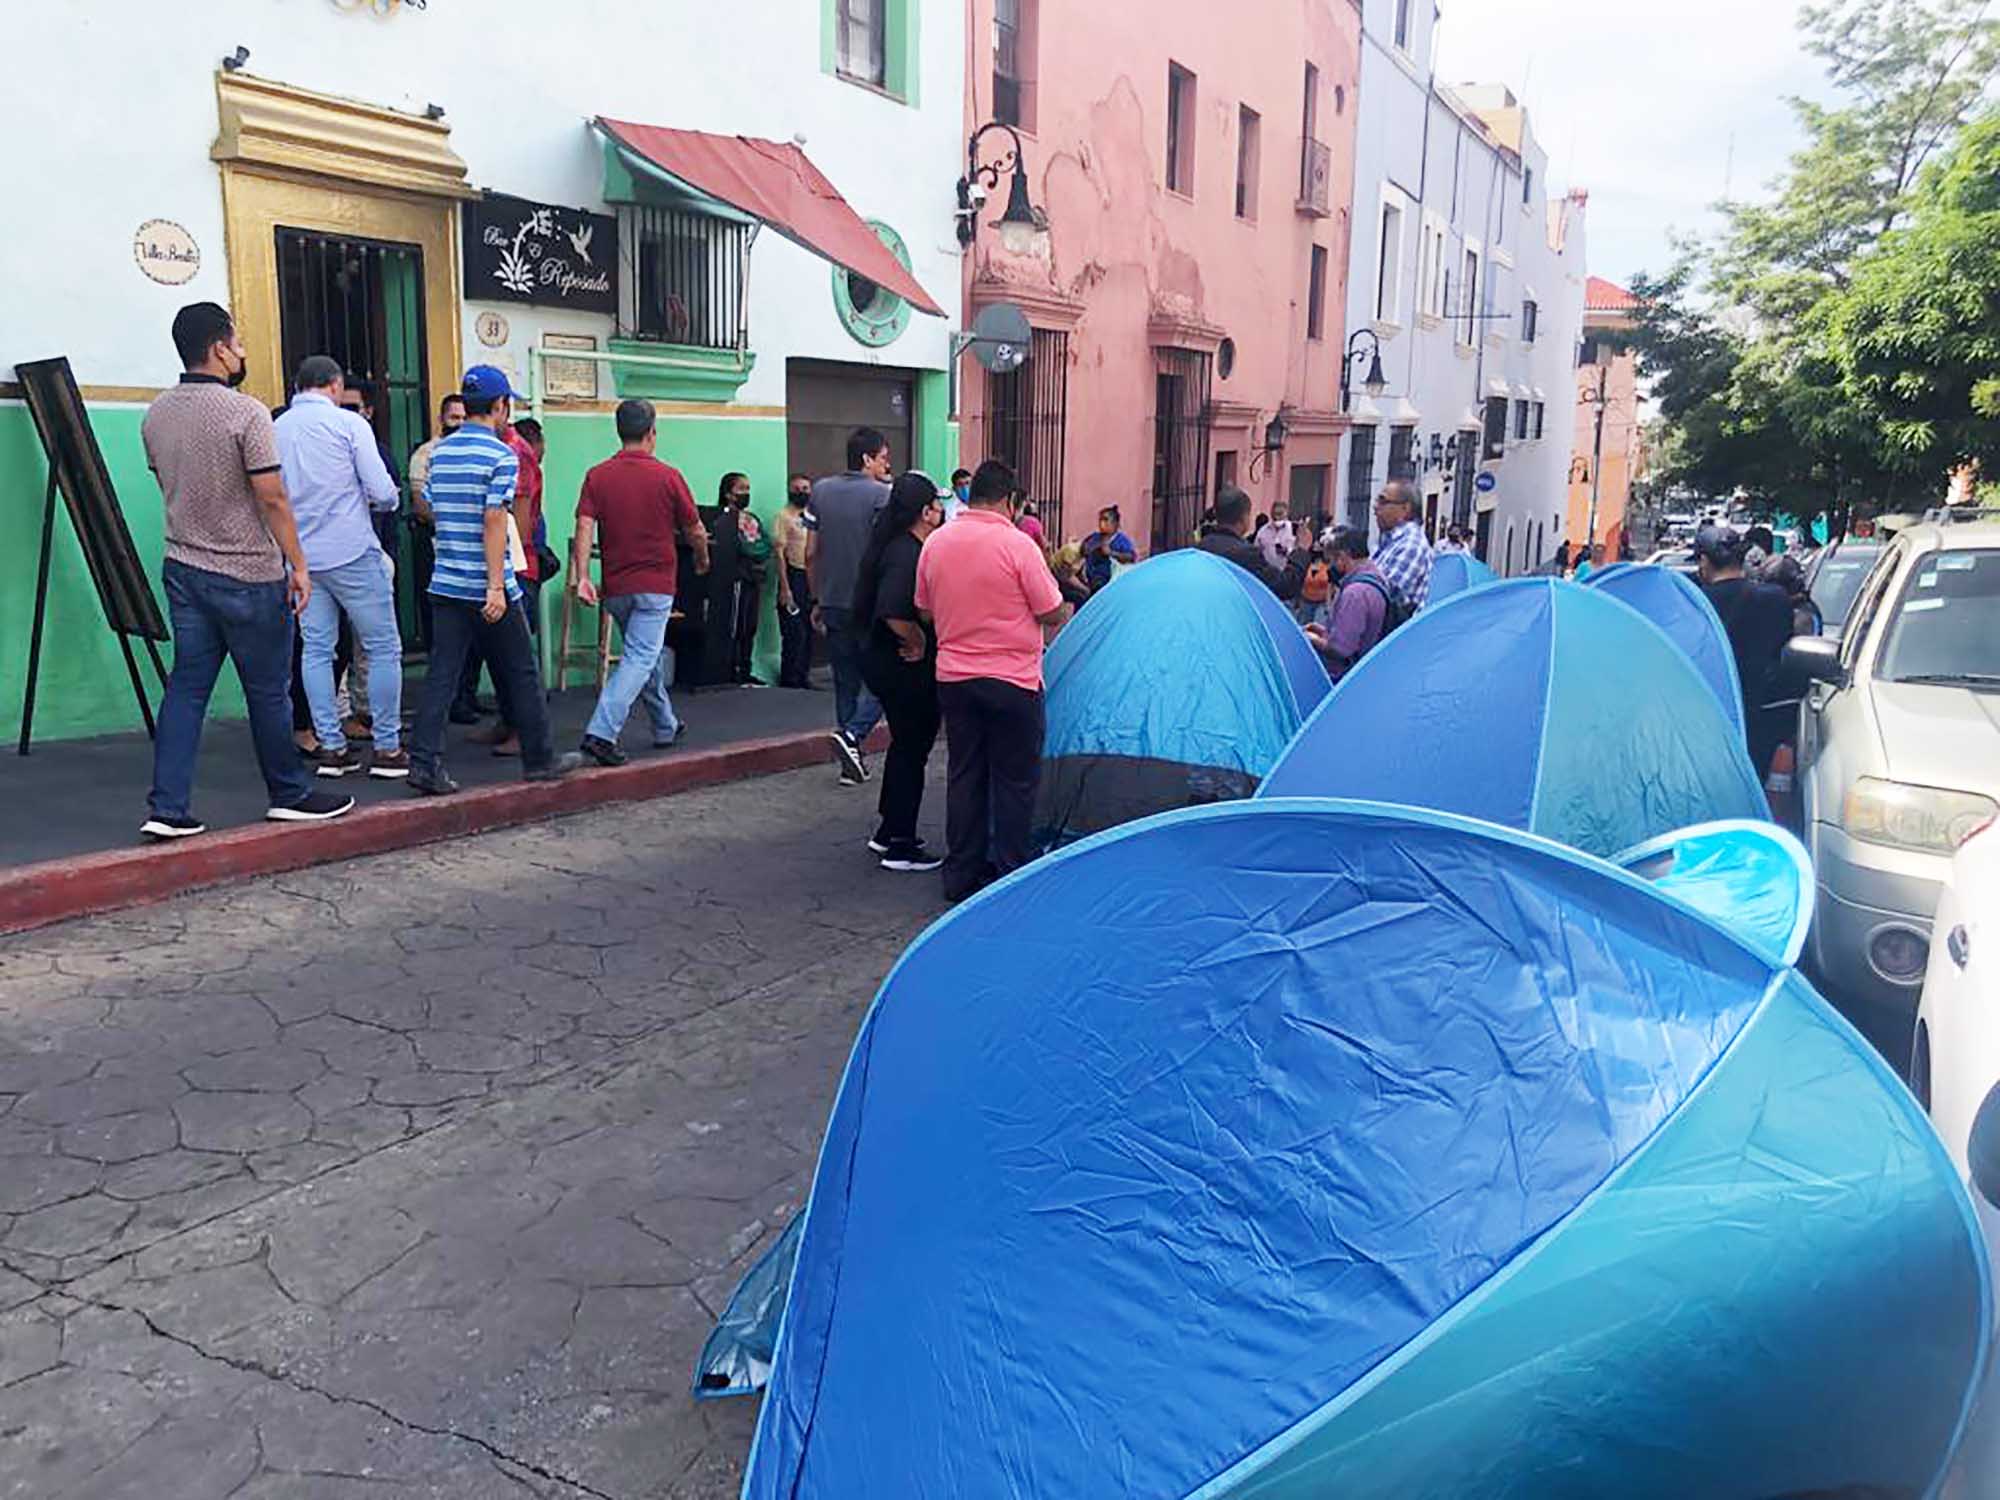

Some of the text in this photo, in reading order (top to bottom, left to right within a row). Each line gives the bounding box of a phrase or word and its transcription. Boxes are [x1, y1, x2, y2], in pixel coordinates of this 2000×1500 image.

[483, 225, 508, 246] Bar
[540, 257, 609, 296] Reposado
[488, 320, 499, 337] 33
